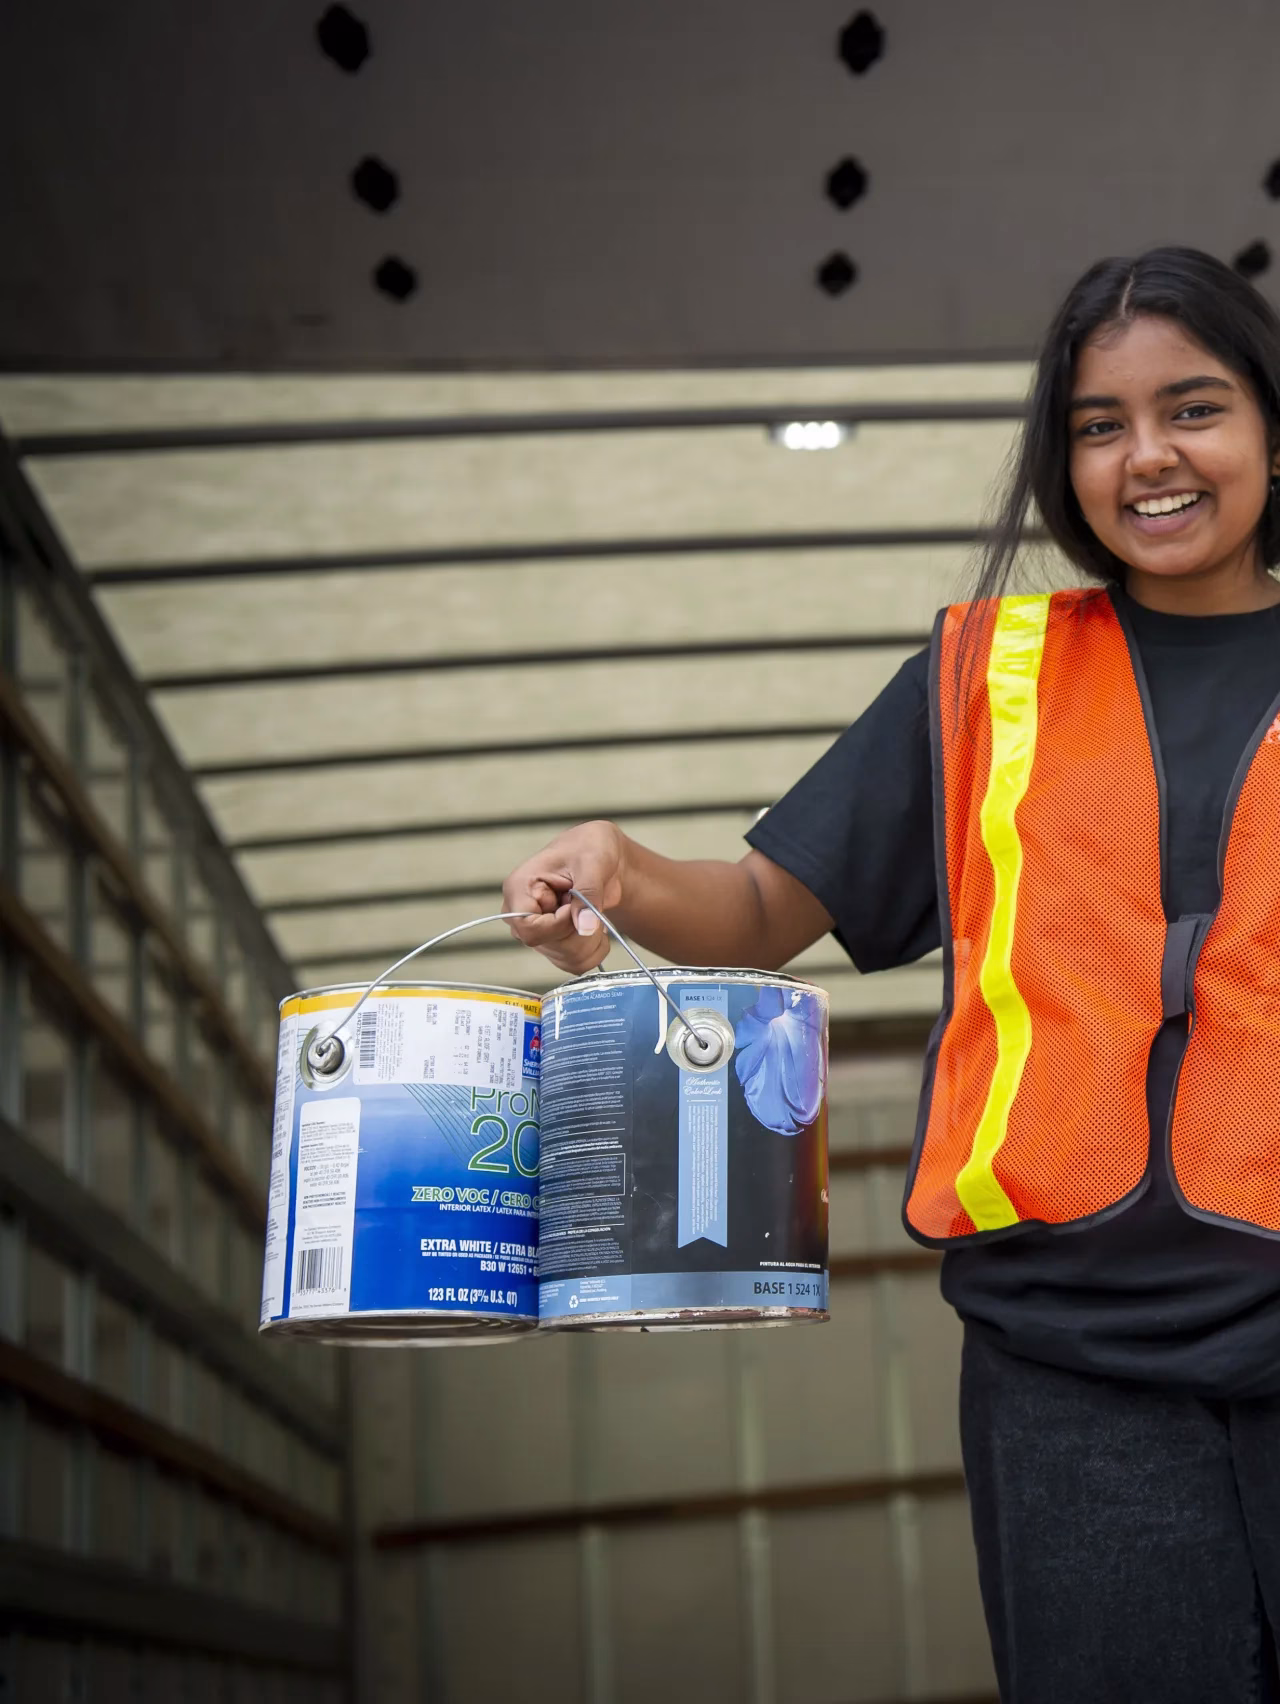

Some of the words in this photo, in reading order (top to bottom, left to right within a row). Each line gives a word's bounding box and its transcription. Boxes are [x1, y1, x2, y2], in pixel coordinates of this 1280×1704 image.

[685, 1076, 721, 1087] Authentic
[683, 1085, 704, 1096] Color
[411, 1186, 455, 1203] ZERO
[455, 1187, 491, 1205] VOC
[491, 1188, 500, 1206] /
[500, 1190, 531, 1209] CERO
[439, 1203, 471, 1212] INTERIOR
[472, 1204, 492, 1213] LATEX
[496, 1205, 513, 1216] LATEX
[512, 1208, 526, 1217] PARA
[420, 1238, 457, 1252] EXTRA
[459, 1239, 492, 1253] WHITE
[500, 1242, 526, 1257] EXTRA
[480, 1260, 497, 1273] B30
[498, 1261, 506, 1274] W
[507, 1262, 527, 1276] 12651
[428, 1287, 444, 1301] 123
[446, 1287, 456, 1302] FL
[458, 1287, 469, 1303] OZ
[490, 1289, 505, 1304] U.S.
[506, 1290, 518, 1308] QT)
[753, 1281, 785, 1295] BASE
[787, 1282, 793, 1296] 1
[795, 1282, 810, 1296] 524
[812, 1283, 822, 1298] 1X
